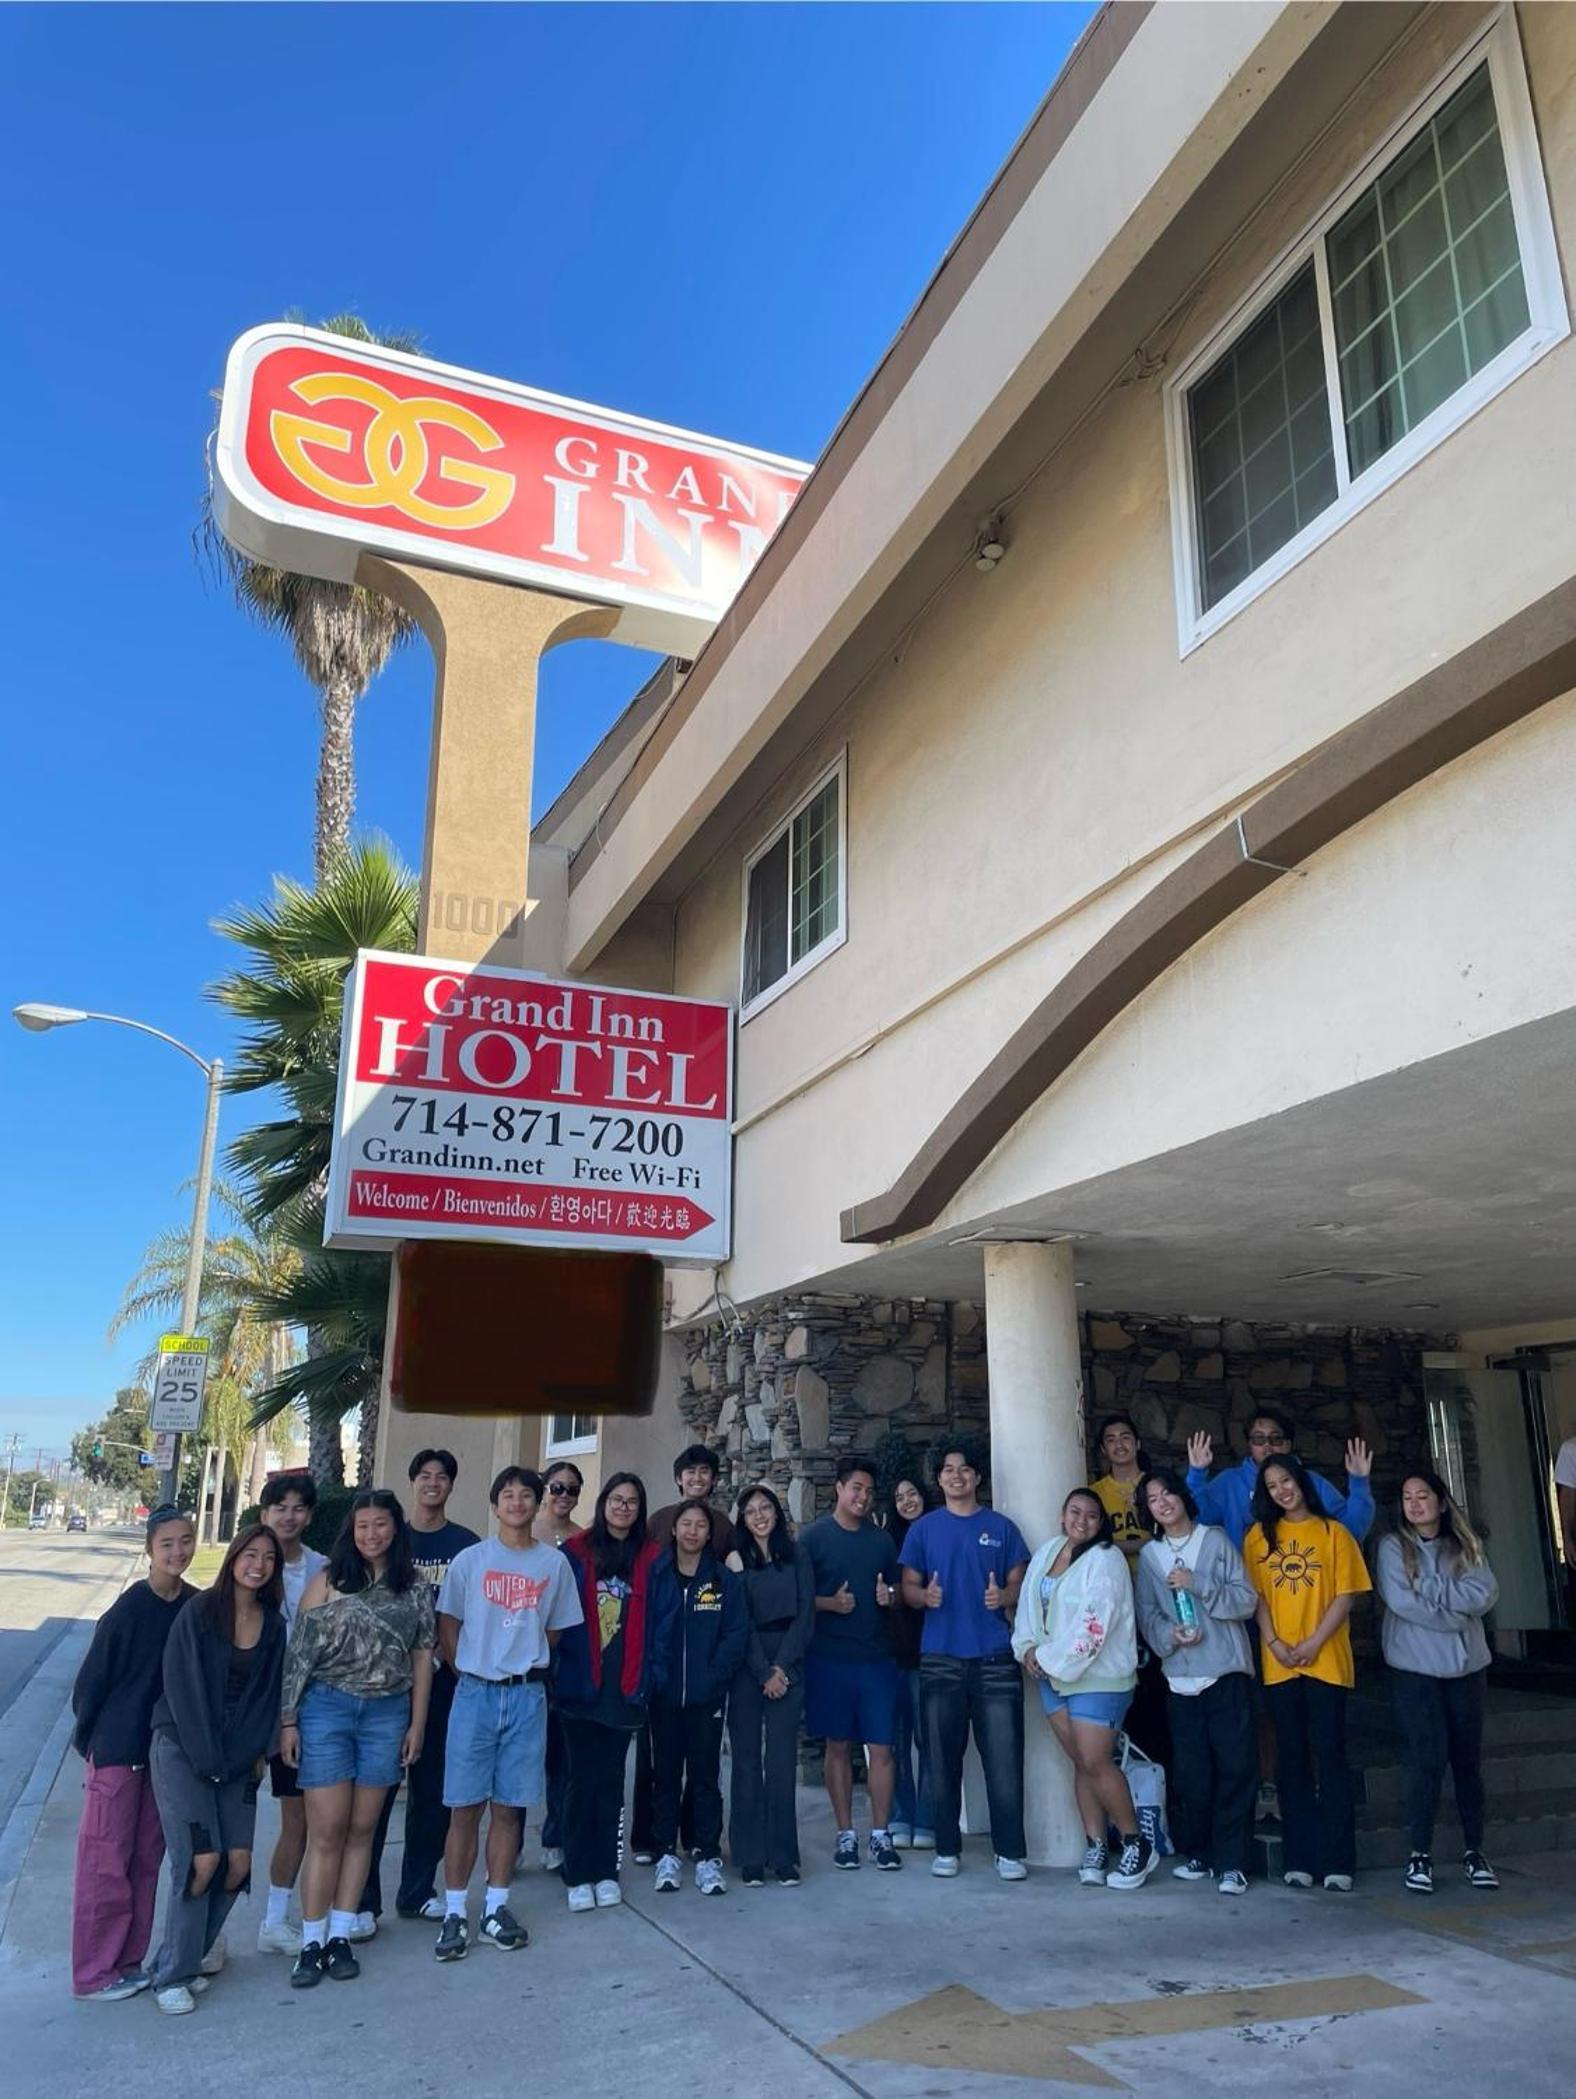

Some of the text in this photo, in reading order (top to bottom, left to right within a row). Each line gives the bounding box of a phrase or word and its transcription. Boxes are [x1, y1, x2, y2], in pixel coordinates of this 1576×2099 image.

[433, 891, 519, 939] 1000
[423, 975, 665, 1042] Grand Inn
[369, 1016, 717, 1110] HOTEL
[391, 1093, 684, 1158] 714-871-7200
[362, 1137, 700, 1189] Grandinn.net Free Wi-Fi
[355, 1181, 429, 1210] Welcome
[443, 1189, 536, 1218] Bienvenidos
[164, 1339, 206, 1351] SCHOOL
[165, 1356, 203, 1366] SPEED
[167, 1368, 196, 1377] LIMIT
[159, 1382, 198, 1402] 25
[486, 1574, 526, 1606] UNITED
